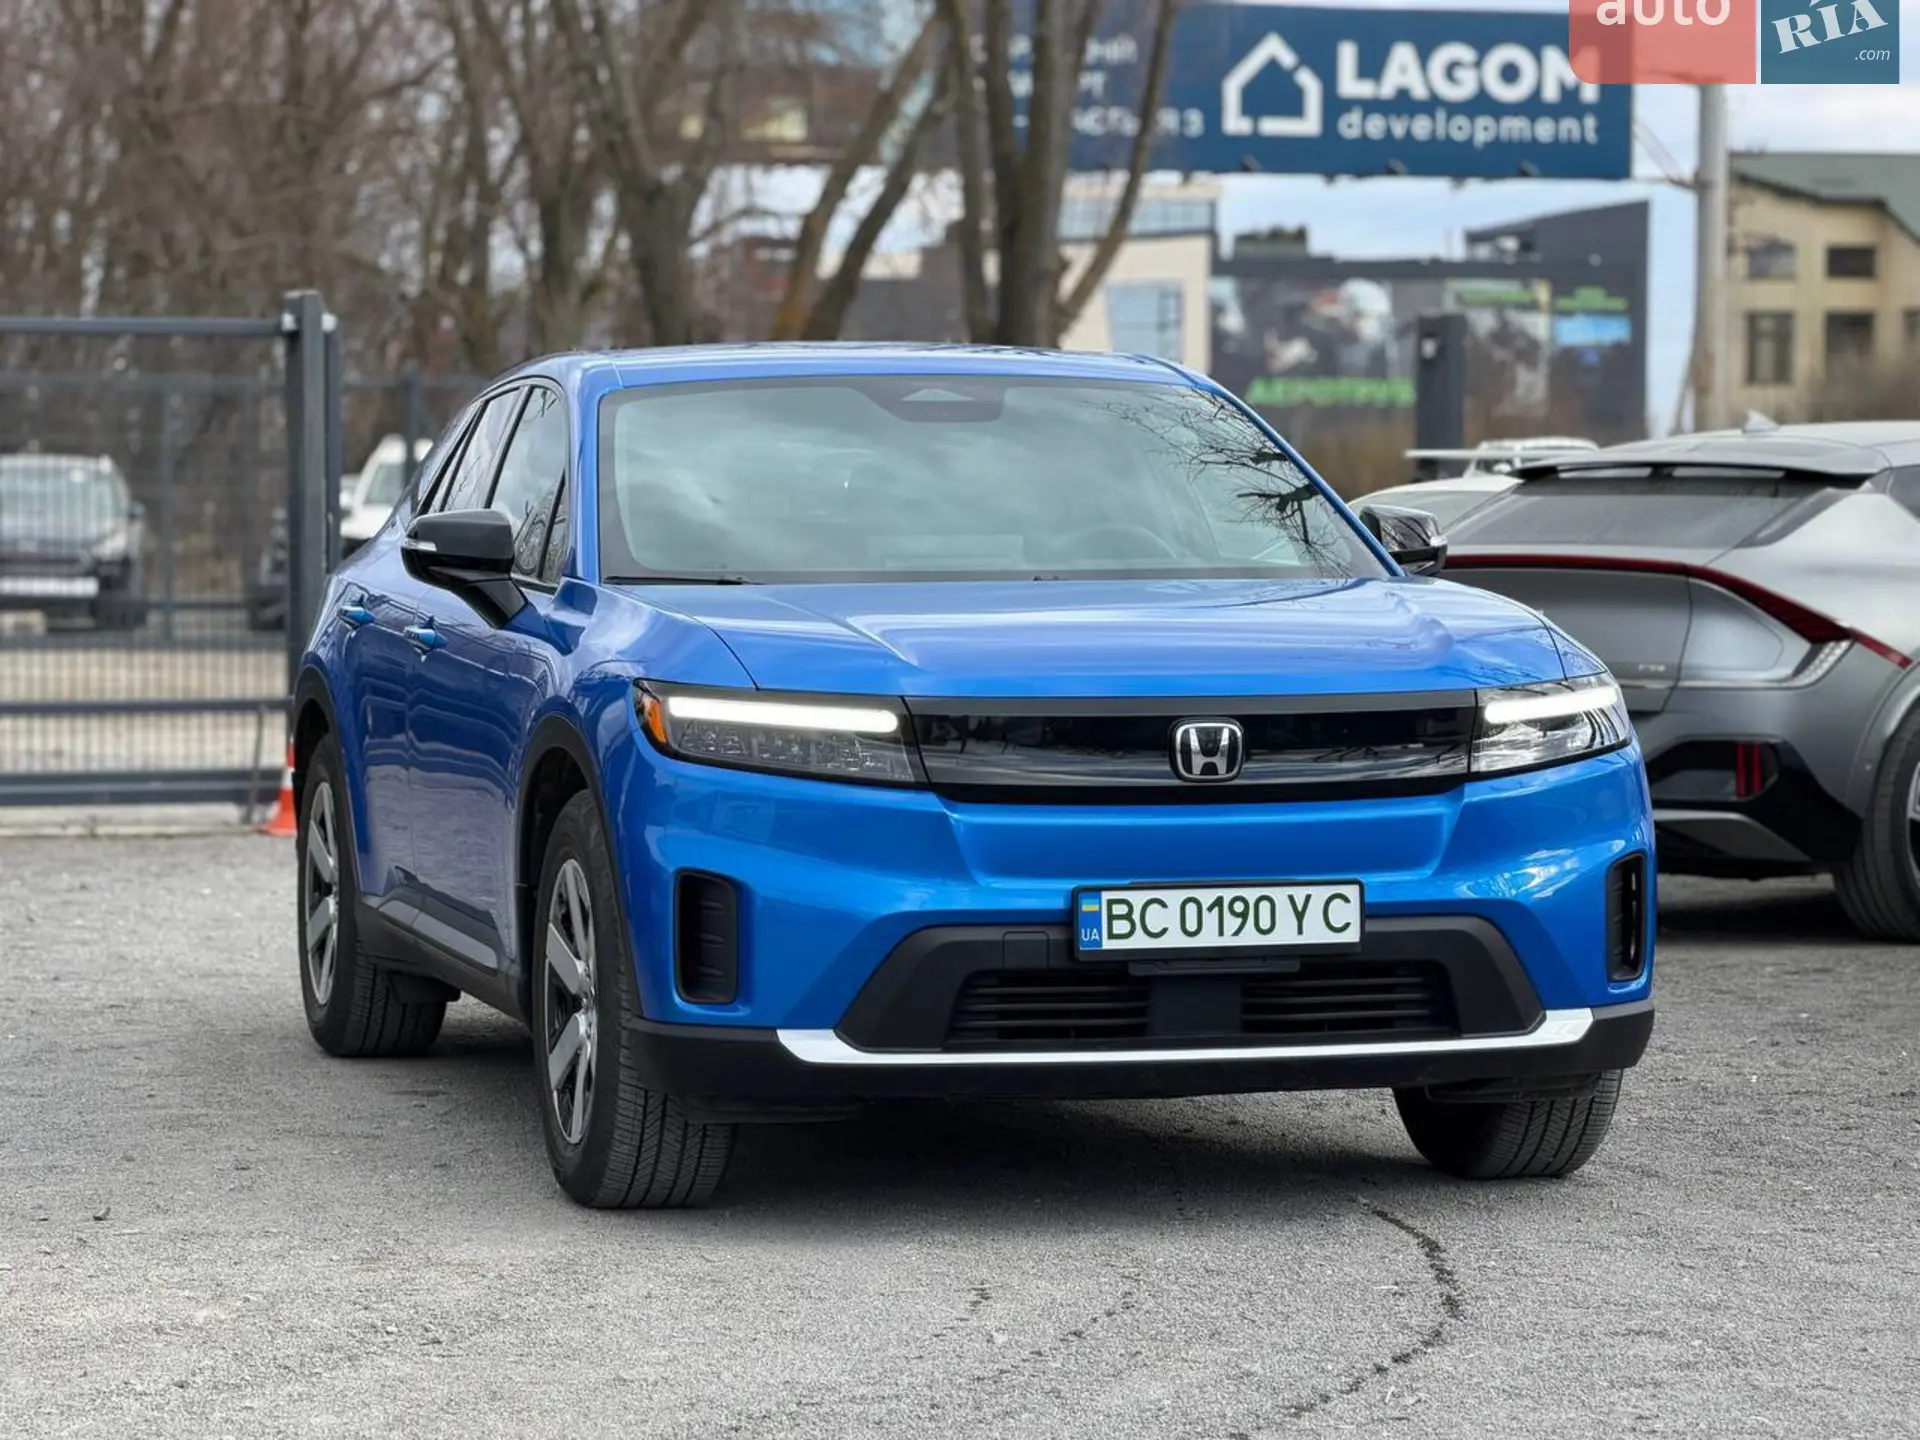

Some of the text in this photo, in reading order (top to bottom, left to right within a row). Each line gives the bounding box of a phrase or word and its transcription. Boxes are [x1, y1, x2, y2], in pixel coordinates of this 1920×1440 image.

[1336, 40, 1600, 103] LAGOM
[1337, 105, 1599, 149] development
[1080, 927, 1100, 942] UA
